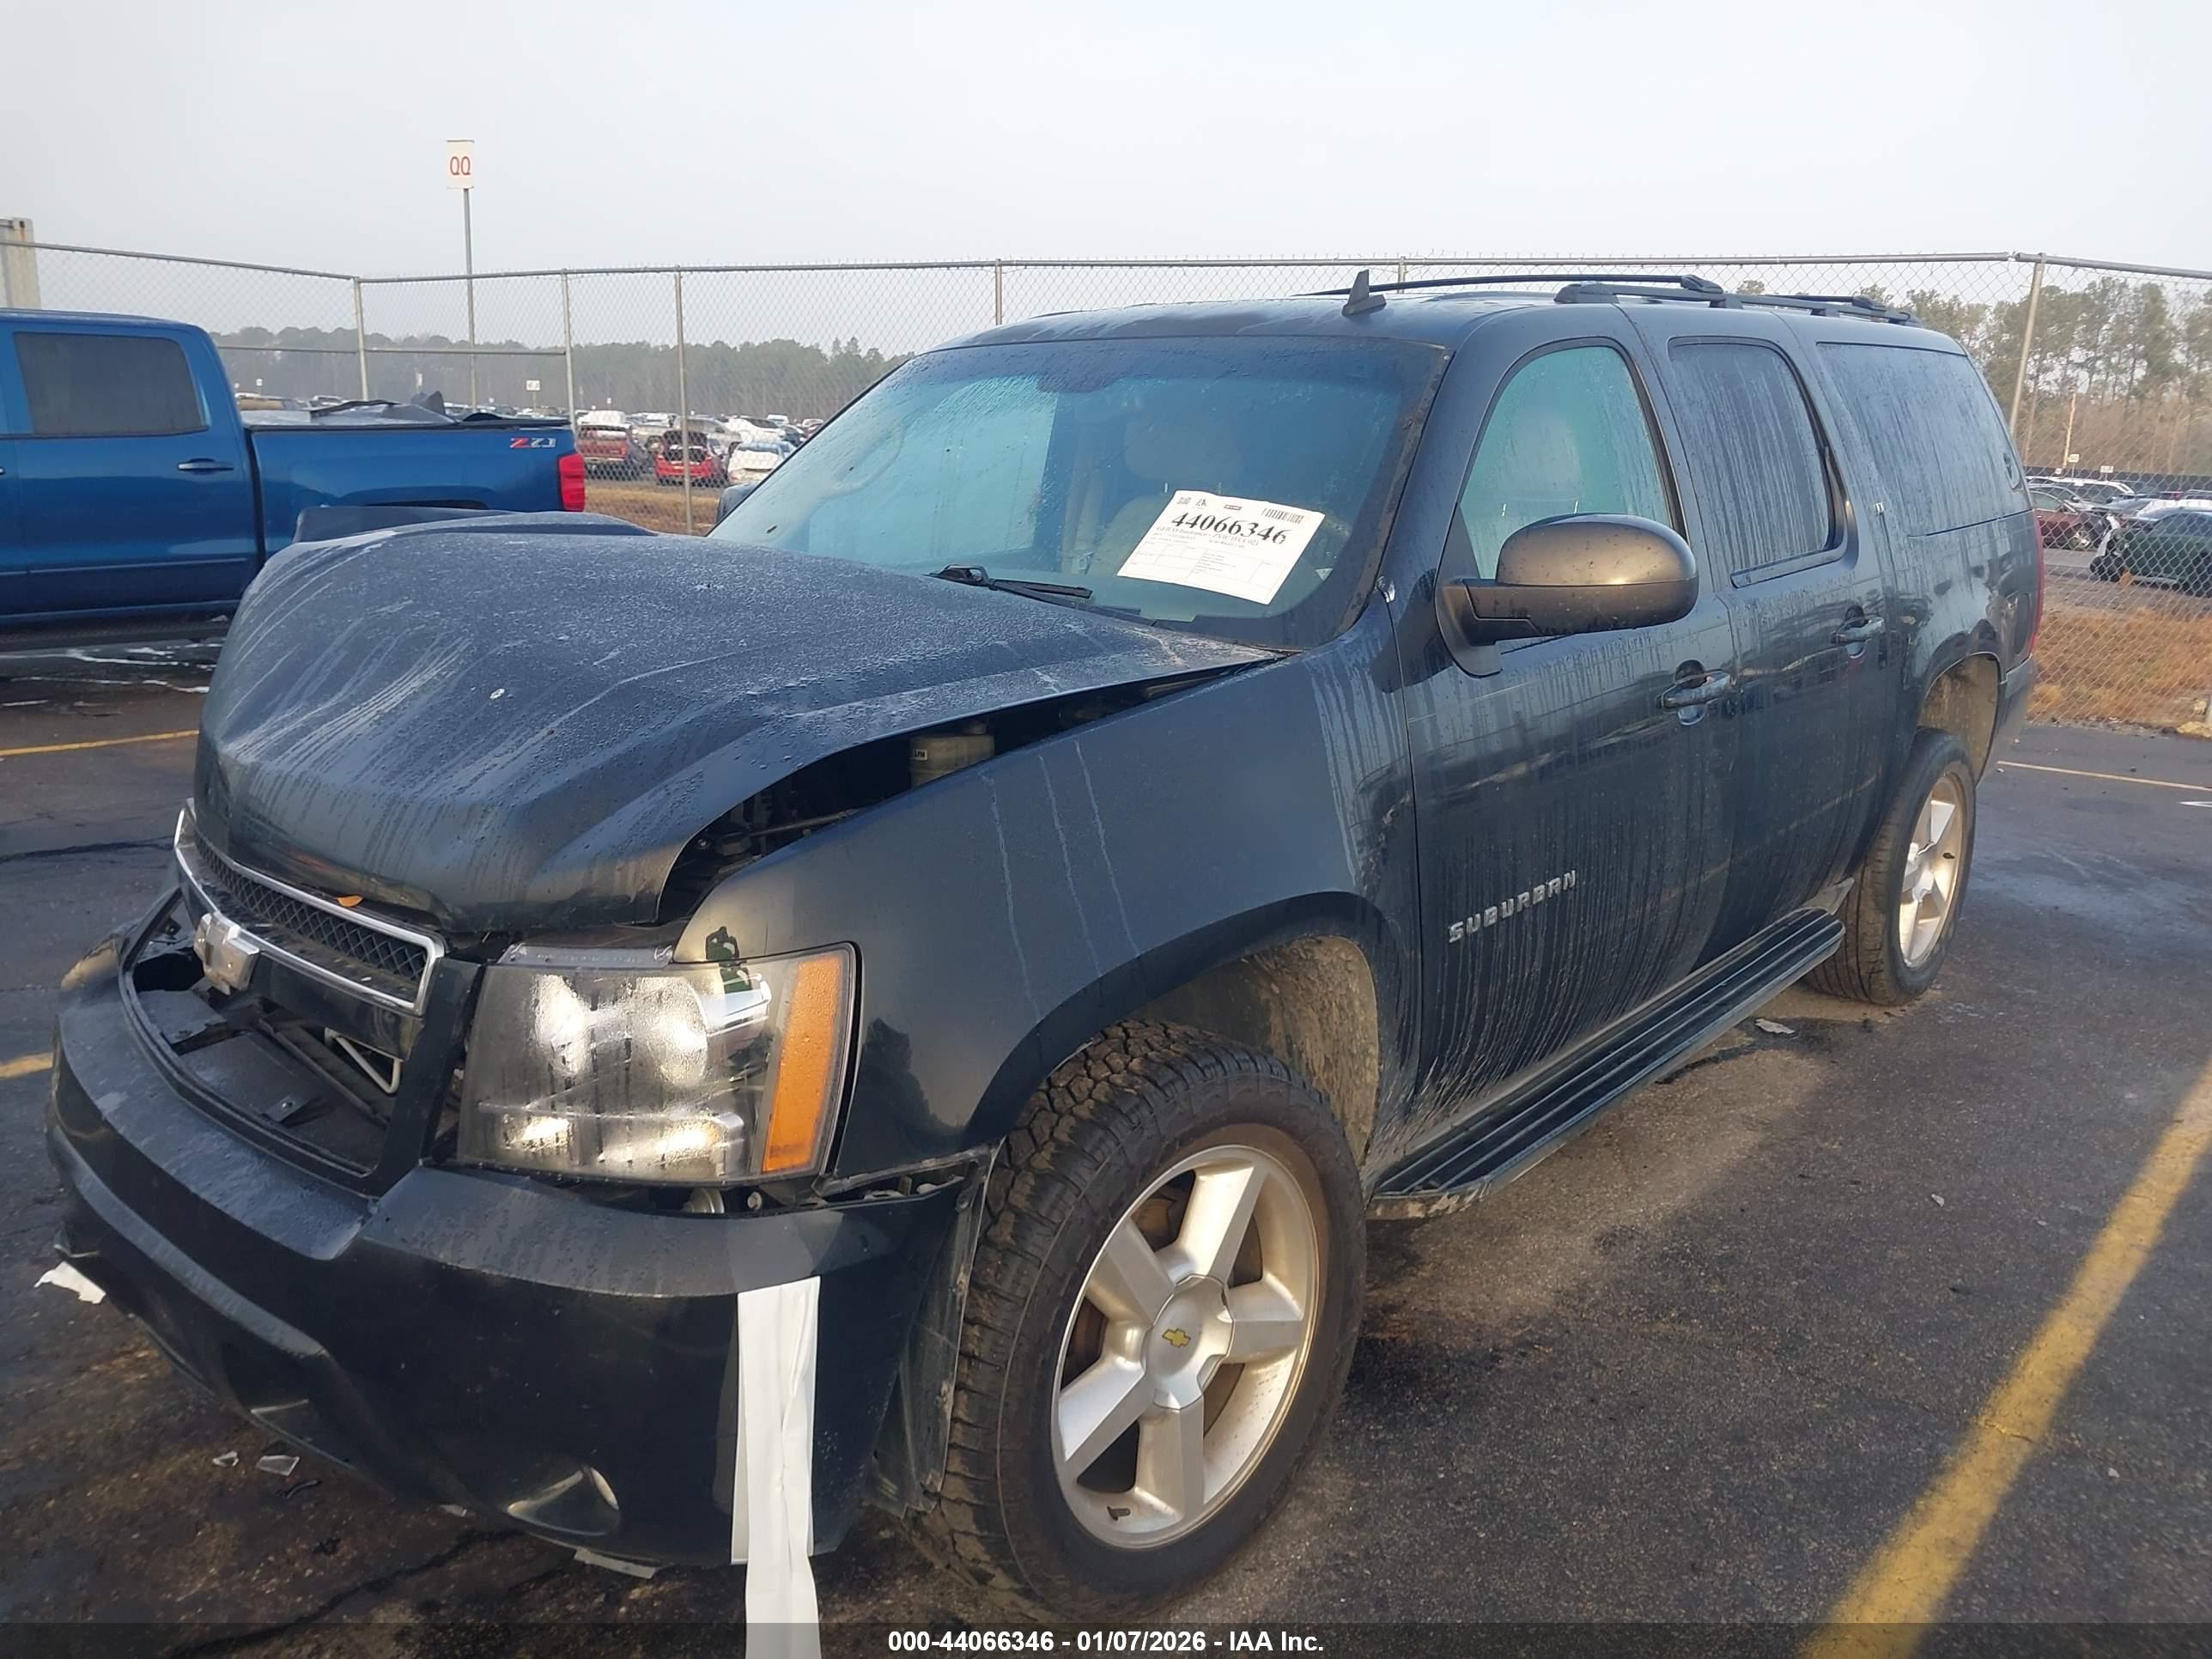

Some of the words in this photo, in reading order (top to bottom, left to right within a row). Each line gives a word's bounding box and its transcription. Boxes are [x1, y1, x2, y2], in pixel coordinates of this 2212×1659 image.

[450, 156, 471, 175] QQ
[509, 437, 556, 448] Z71
[1171, 512, 1291, 544] 44066346
[1449, 870, 1576, 943] SUBURBAN
